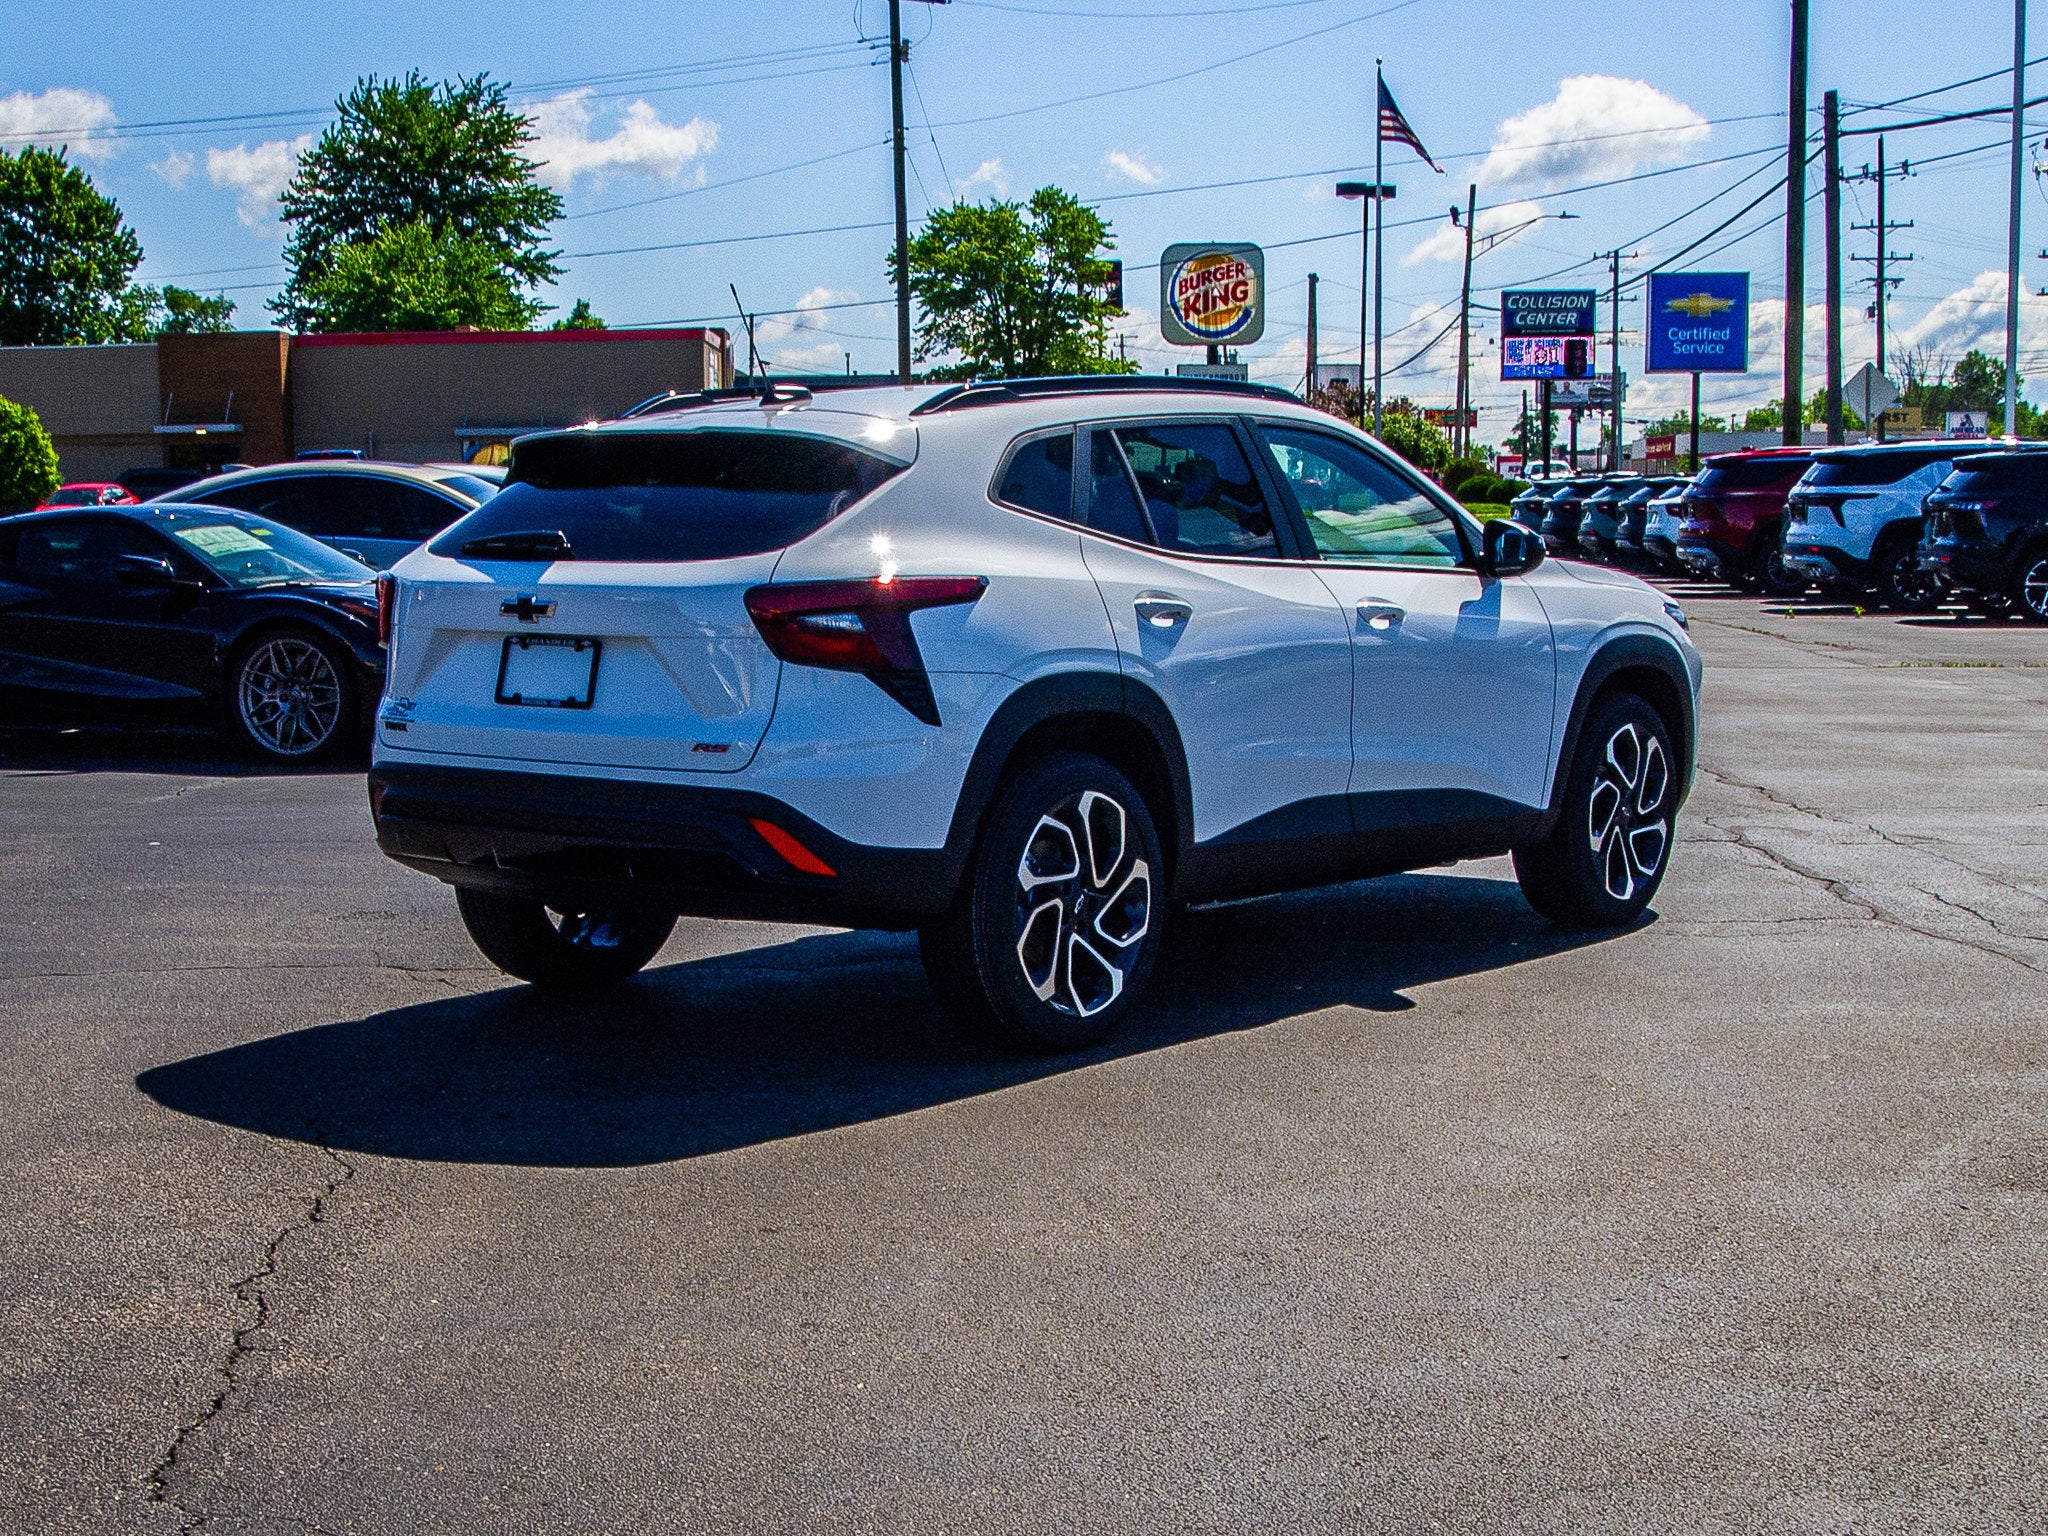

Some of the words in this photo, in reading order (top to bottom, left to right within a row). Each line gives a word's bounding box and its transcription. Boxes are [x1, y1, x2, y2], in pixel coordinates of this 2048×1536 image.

[1179, 262, 1245, 297] BURGER
[1183, 280, 1249, 322] KING
[1508, 295, 1589, 309] COLLISION
[1515, 311, 1578, 326] CENTER
[1668, 327, 1730, 341] Certified
[1673, 341, 1725, 355] Service
